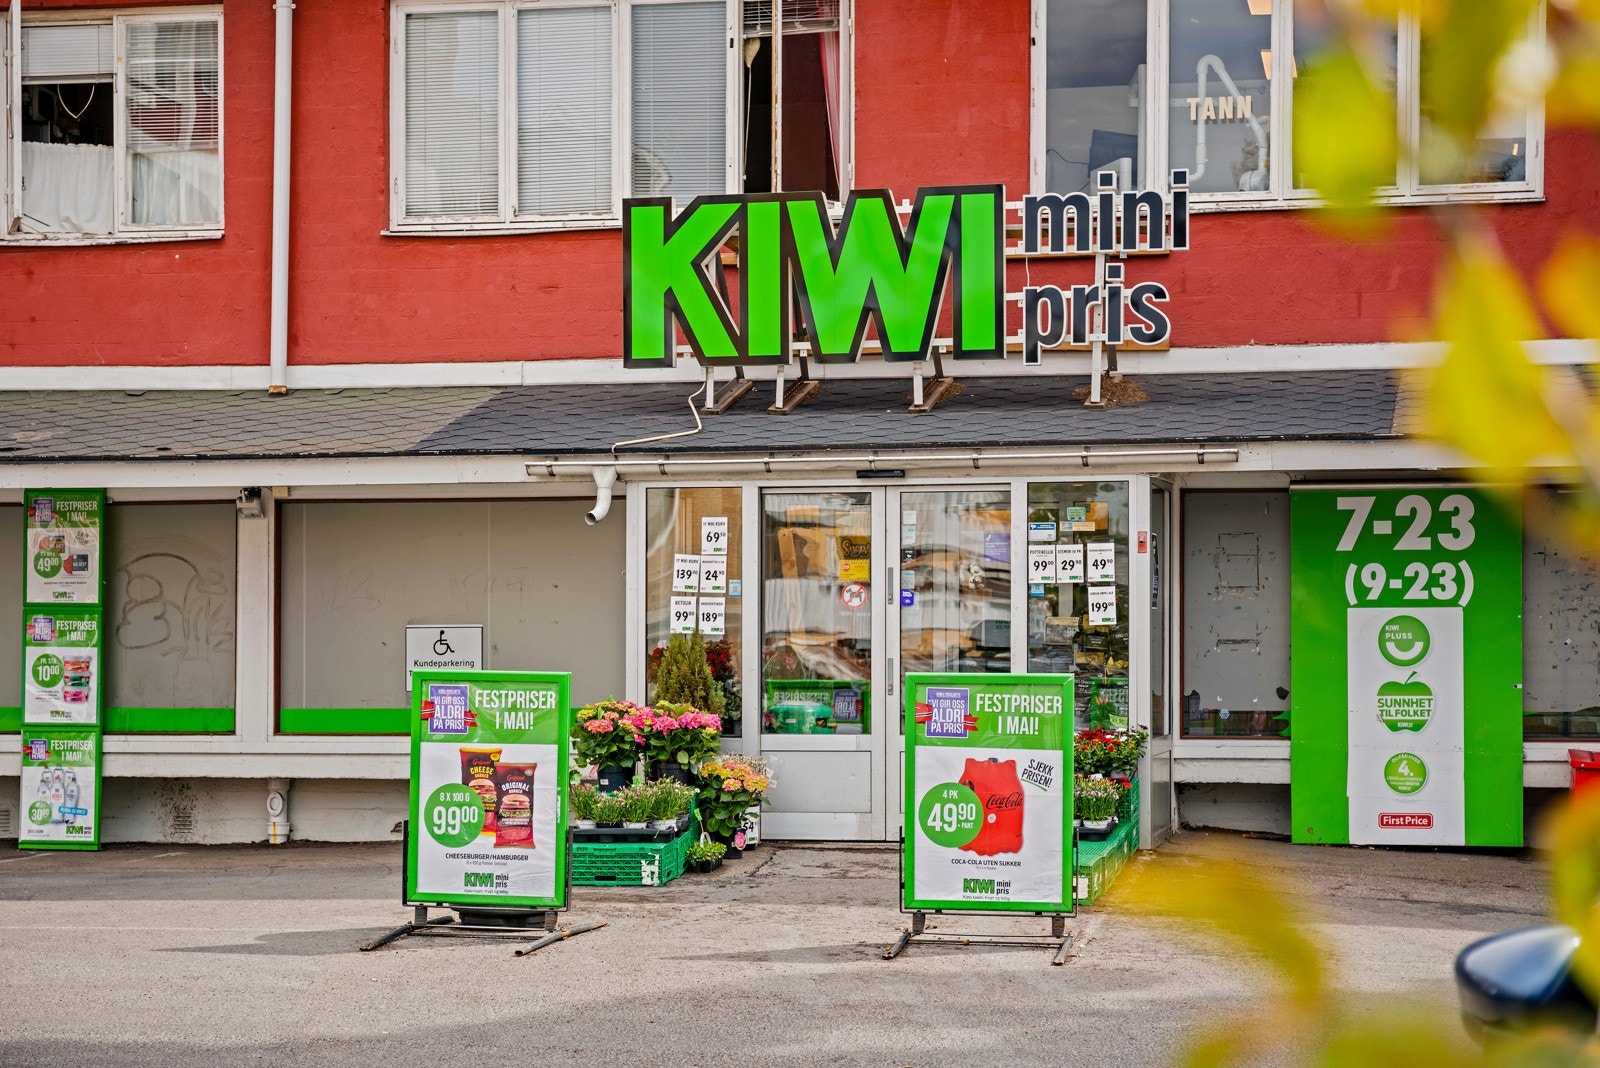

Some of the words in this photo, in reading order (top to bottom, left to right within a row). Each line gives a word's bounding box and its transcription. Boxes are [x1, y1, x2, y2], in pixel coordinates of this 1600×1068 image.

[1186, 95, 1252, 121] TANN
[1022, 168, 1190, 254] mini
[623, 184, 1006, 368] KIWI
[1022, 262, 1171, 366] pris
[56, 501, 98, 511] FESTPRISER
[1335, 494, 1475, 552] 7-23
[1345, 560, 1474, 607] (9-23)
[56, 620, 97, 631] FESTPRISER
[1385, 632, 1413, 640] PLUSS
[413, 660, 475, 668] Kundeparkering
[475, 690, 556, 709] FESTPRISER
[940, 699, 951, 708] GIR
[952, 700, 965, 708] OSS
[976, 693, 1062, 714] FESTPRISER
[1377, 698, 1434, 708] SUNNHET
[434, 704, 464, 719] ALDRI
[932, 708, 965, 723] ALDRI
[1379, 709, 1394, 717] TIL
[1395, 709, 1432, 717] FOLKET
[445, 719, 465, 730] PRIS!
[495, 712, 500, 730] I
[504, 712, 534, 730] MAI!
[998, 716, 1002, 734] I
[1007, 716, 1039, 735] MAI!
[944, 722, 964, 734] PRIS!
[51, 740, 93, 750] FESTPRISER
[470, 766, 494, 775] CHEESE
[1028, 758, 1054, 777] SJEKK
[1398, 760, 1414, 776] 4.
[1021, 768, 1053, 788] PRISEN!
[501, 782, 530, 791] ORIGINAL
[942, 790, 947, 799] 4
[950, 790, 958, 799] PK
[1383, 816, 1404, 825] First
[1405, 816, 1428, 825] Price
[445, 852, 529, 861] CHEESEBURGER/HAMBURGER
[951, 858, 982, 866] COCA-COLA
[464, 872, 494, 887] KIWI
[495, 881, 508, 889] pris
[996, 880, 1011, 888] mini
[963, 878, 995, 894] KIWI
[996, 887, 1010, 895] pris
